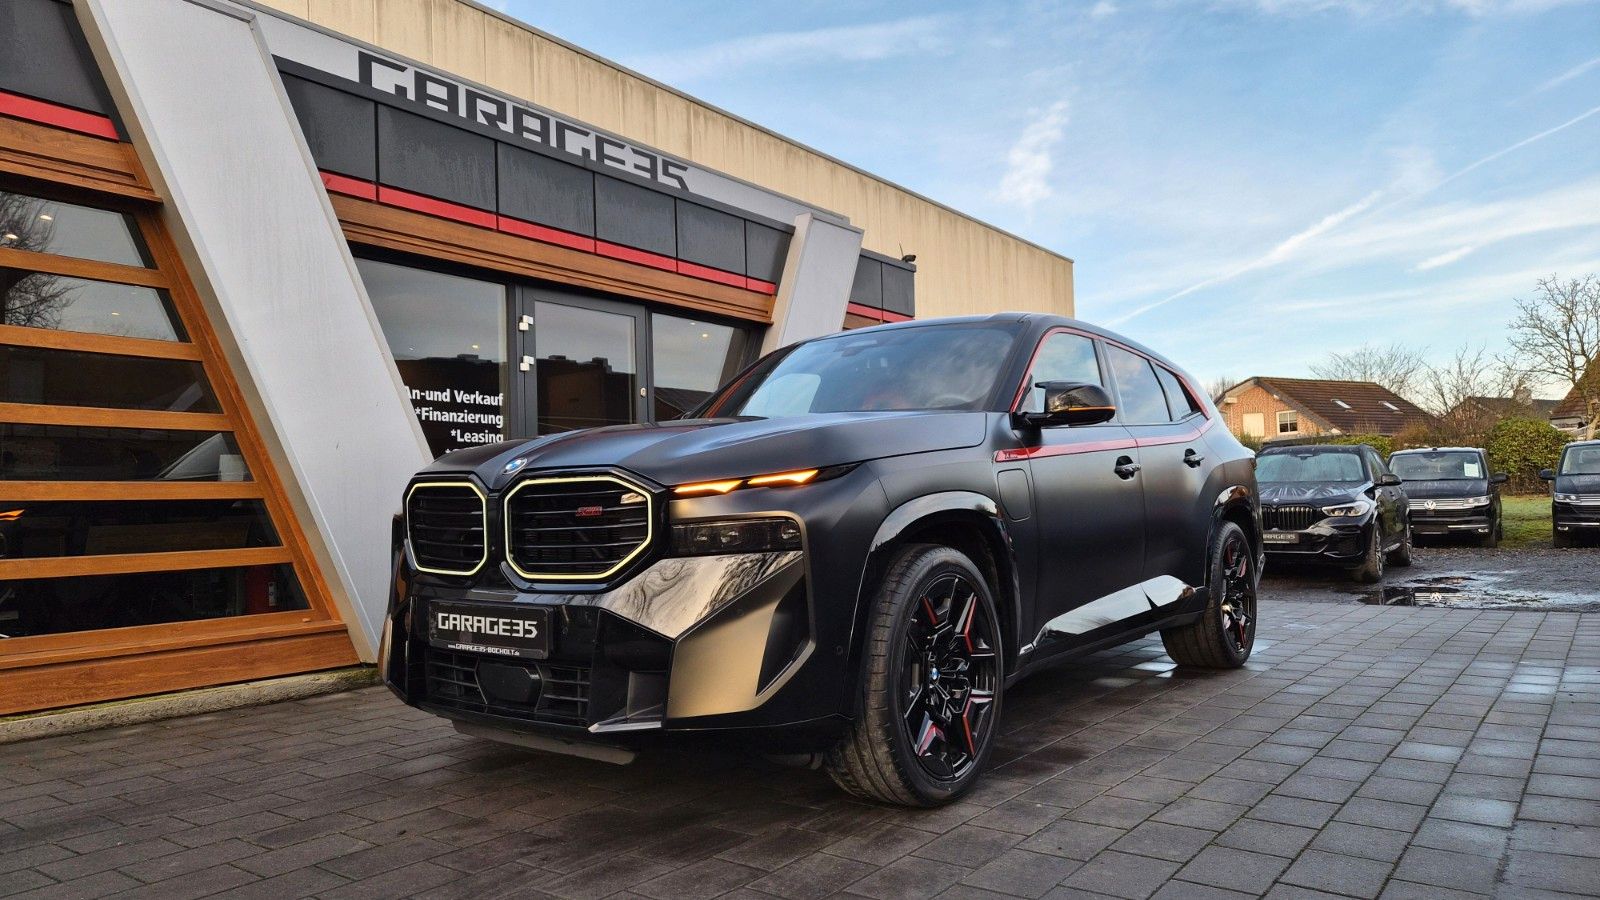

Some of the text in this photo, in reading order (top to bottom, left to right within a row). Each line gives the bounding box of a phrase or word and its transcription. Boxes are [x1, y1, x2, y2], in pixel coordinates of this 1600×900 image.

[358, 50, 690, 192] GARAGE35
[454, 390, 504, 406] Verkauf
[437, 612, 538, 639] GARAGE35
